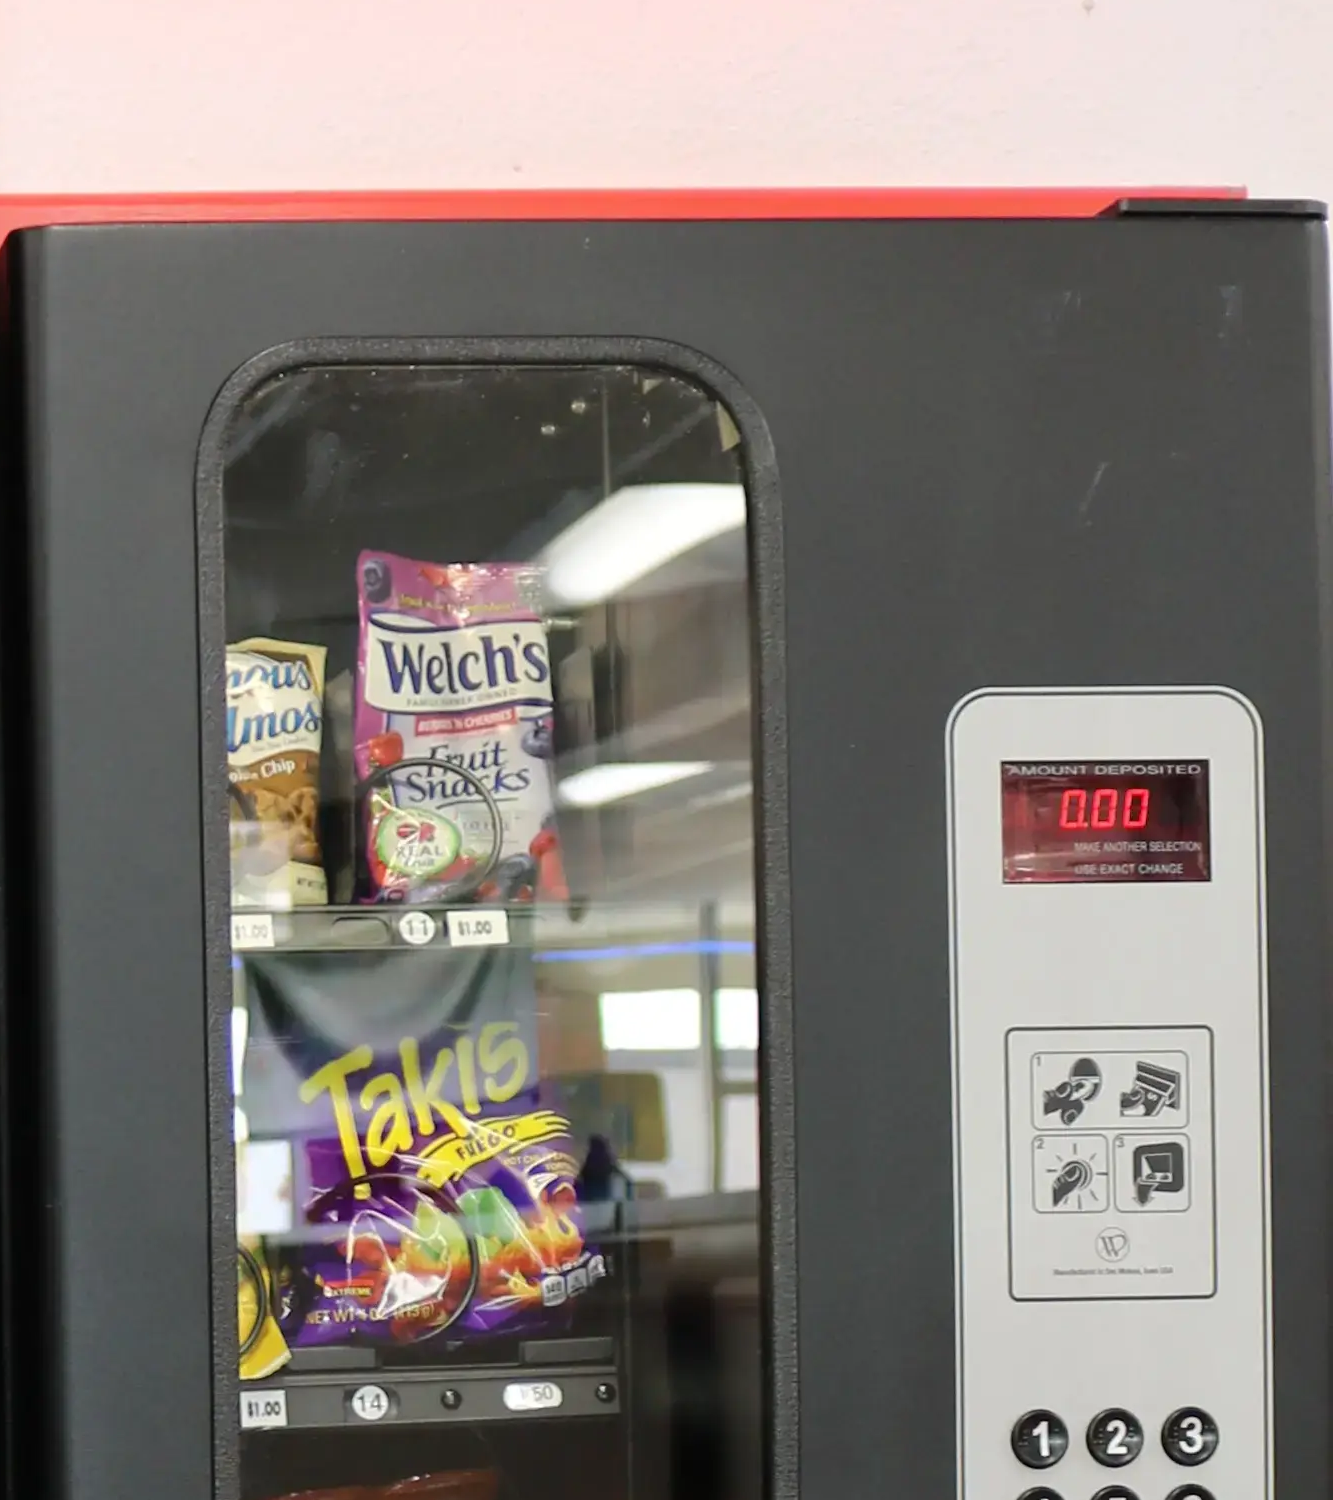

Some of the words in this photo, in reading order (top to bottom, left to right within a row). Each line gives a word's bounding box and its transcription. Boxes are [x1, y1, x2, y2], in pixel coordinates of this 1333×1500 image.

[376, 632, 548, 695] Welch's
[426, 740, 508, 778] Fruit
[1007, 764, 1088, 777] AMOUNT
[1093, 764, 1202, 776] DEPOSITED
[405, 767, 531, 803] Snacks
[1059, 788, 1150, 829] 0.00
[1074, 841, 1102, 853] MAKE
[1102, 841, 1148, 852] ANOTHER
[1149, 840, 1202, 852] SELECTION
[1074, 864, 1098, 875] USE
[1099, 863, 1135, 875] EXACT
[1137, 862, 1184, 874] CHANGE
[407, 919, 429, 936] 11
[457, 919, 493, 936] $1.00
[299, 1020, 531, 1200] Takis
[455, 1124, 517, 1162] FUEGO
[247, 1400, 282, 1417] $1.00
[356, 1393, 383, 1412] 14
[1032, 1420, 1050, 1457] 1
[1106, 1419, 1129, 1455] 2
[1178, 1416, 1204, 1455] 3
